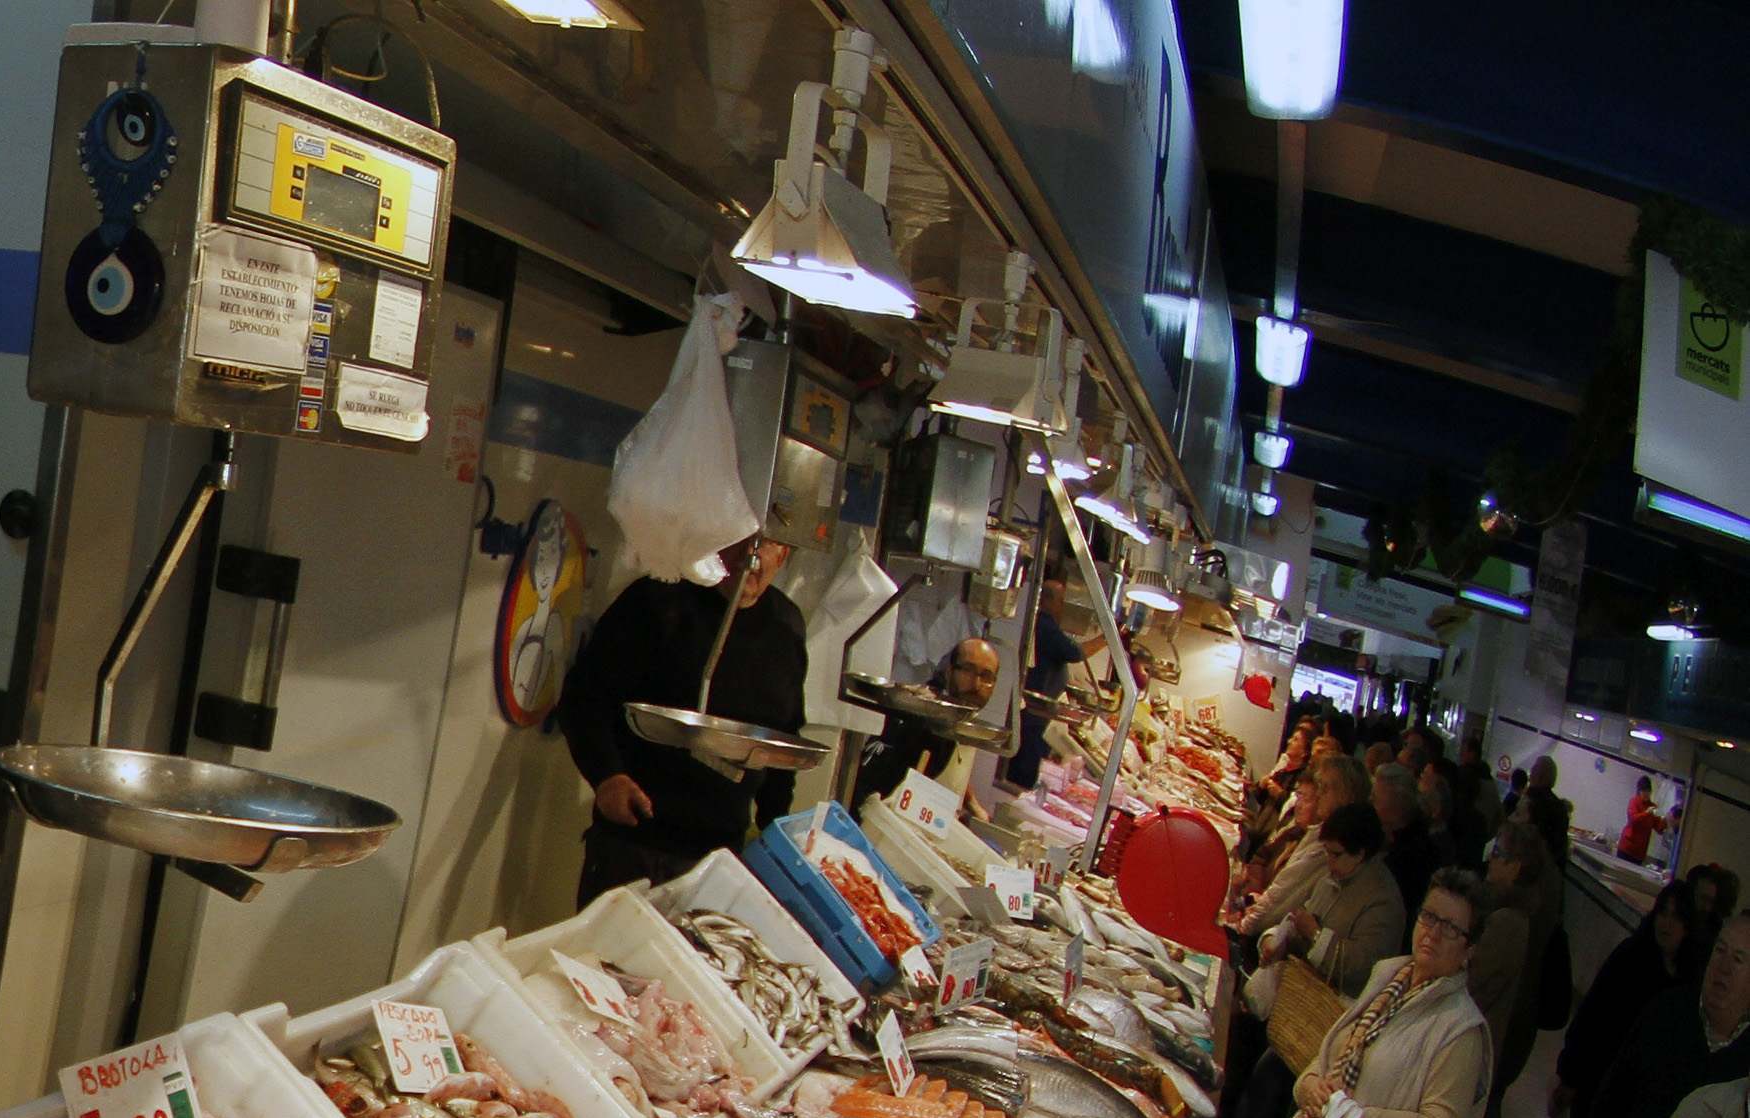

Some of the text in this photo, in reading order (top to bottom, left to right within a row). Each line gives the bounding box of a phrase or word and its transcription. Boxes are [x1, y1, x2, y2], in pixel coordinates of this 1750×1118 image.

[219, 285, 259, 302] TENEMOS
[1686, 347, 1730, 373] mercats
[393, 1037, 412, 1077] 5
